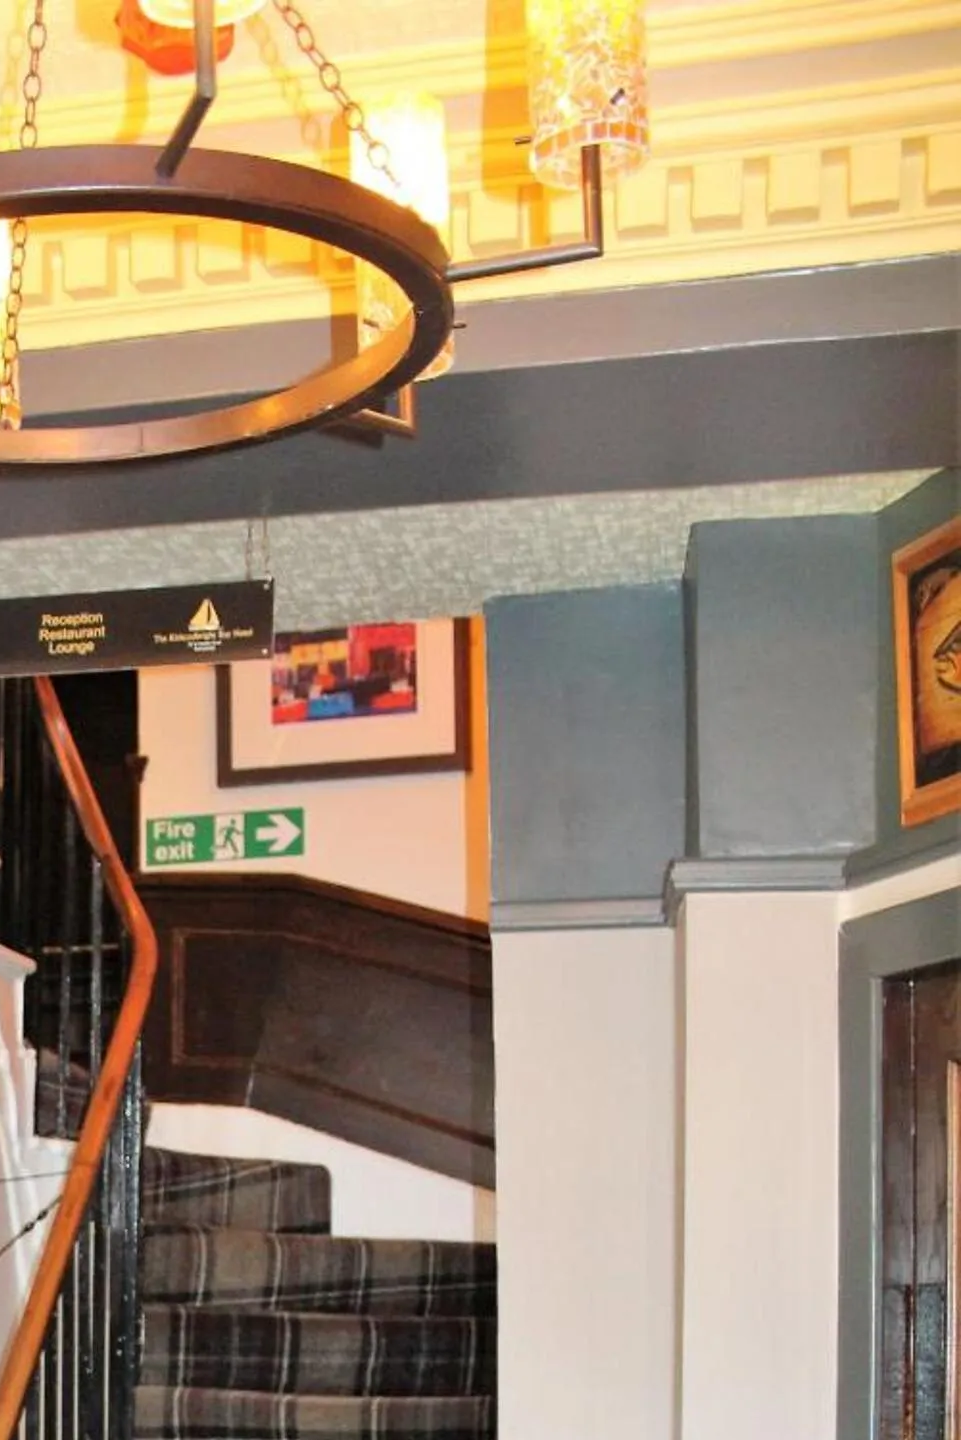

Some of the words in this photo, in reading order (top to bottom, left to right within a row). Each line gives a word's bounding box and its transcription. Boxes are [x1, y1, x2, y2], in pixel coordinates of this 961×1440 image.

[41, 613, 104, 627] Reception
[39, 625, 106, 642] Restaurant
[48, 640, 96, 655] Lounge
[153, 820, 196, 841] Fire
[154, 841, 195, 862] exit
